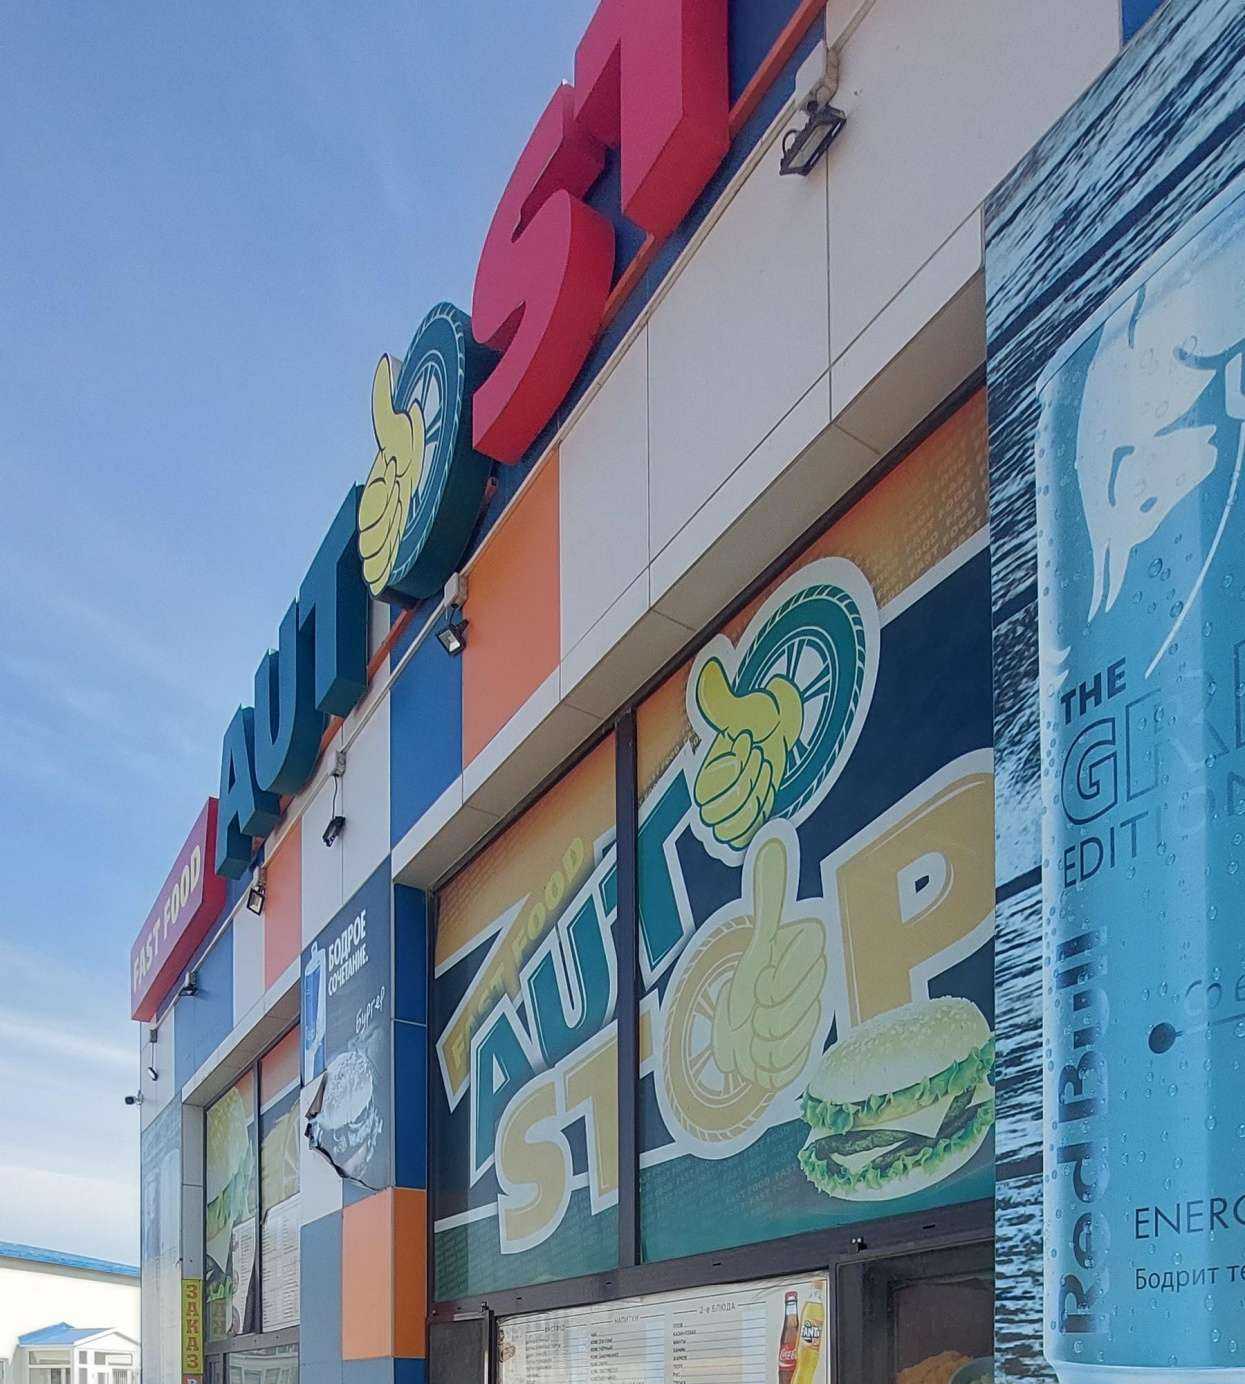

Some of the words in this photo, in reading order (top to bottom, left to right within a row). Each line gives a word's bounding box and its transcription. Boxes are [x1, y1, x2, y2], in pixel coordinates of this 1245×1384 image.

[1060, 657, 1127, 725] THE
[1061, 638, 1245, 826] GR
[133, 918, 161, 993] FAST
[163, 844, 201, 940] FOOD
[511, 836, 585, 957] FOOD
[328, 909, 367, 972] БОДРОЕ
[328, 943, 369, 996] СОЧЕТАНИЕ.
[1136, 1266, 1220, 1293] Бодрит
[185, 1284, 199, 1370] ЗАКАЗ
